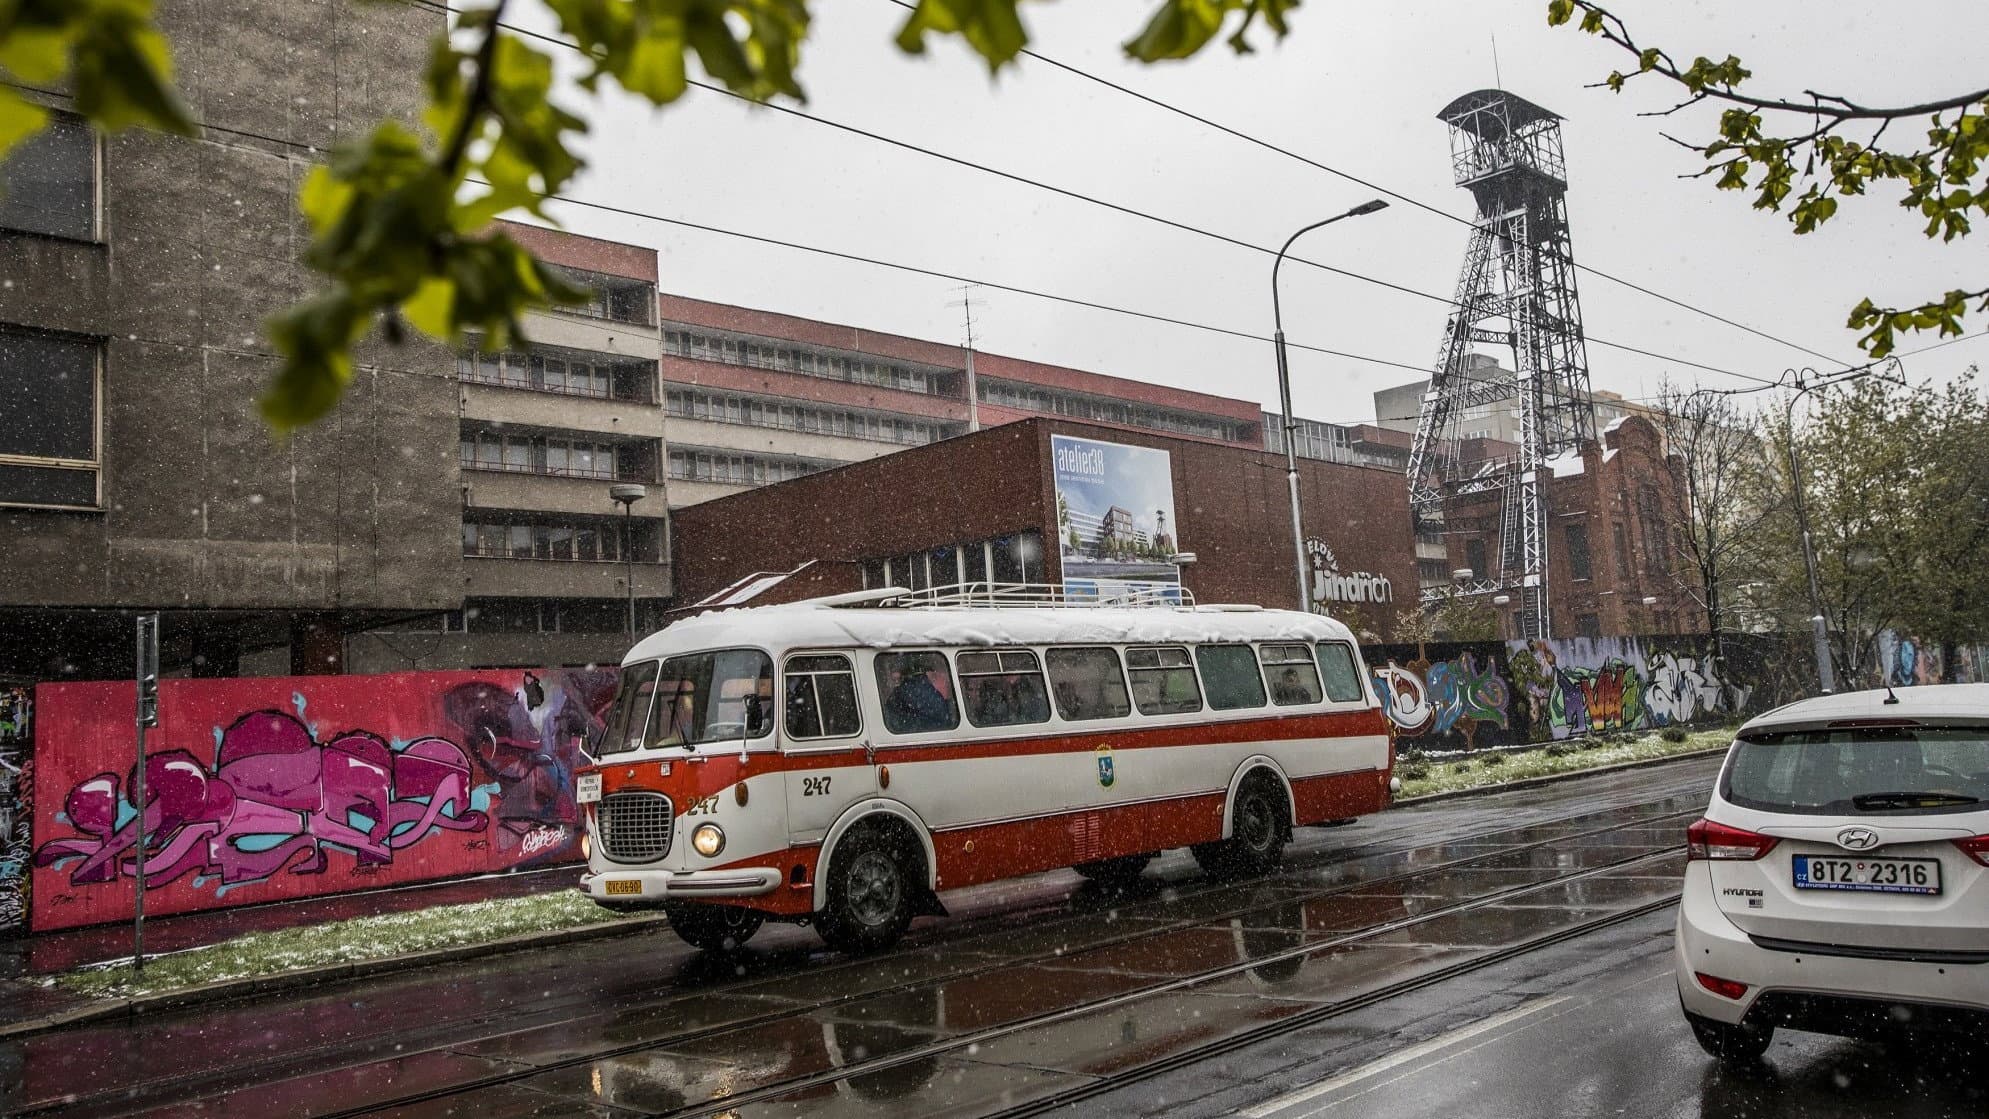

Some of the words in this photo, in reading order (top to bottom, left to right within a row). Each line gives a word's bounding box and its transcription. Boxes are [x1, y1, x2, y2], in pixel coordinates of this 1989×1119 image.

[1058, 446, 1105, 475] atelier38
[803, 776, 832, 796] 247
[687, 795, 720, 816] 247
[1812, 860, 1853, 883] 8T2
[1870, 862, 1928, 886] 2316
[1723, 888, 1764, 897] HYUNDAI
